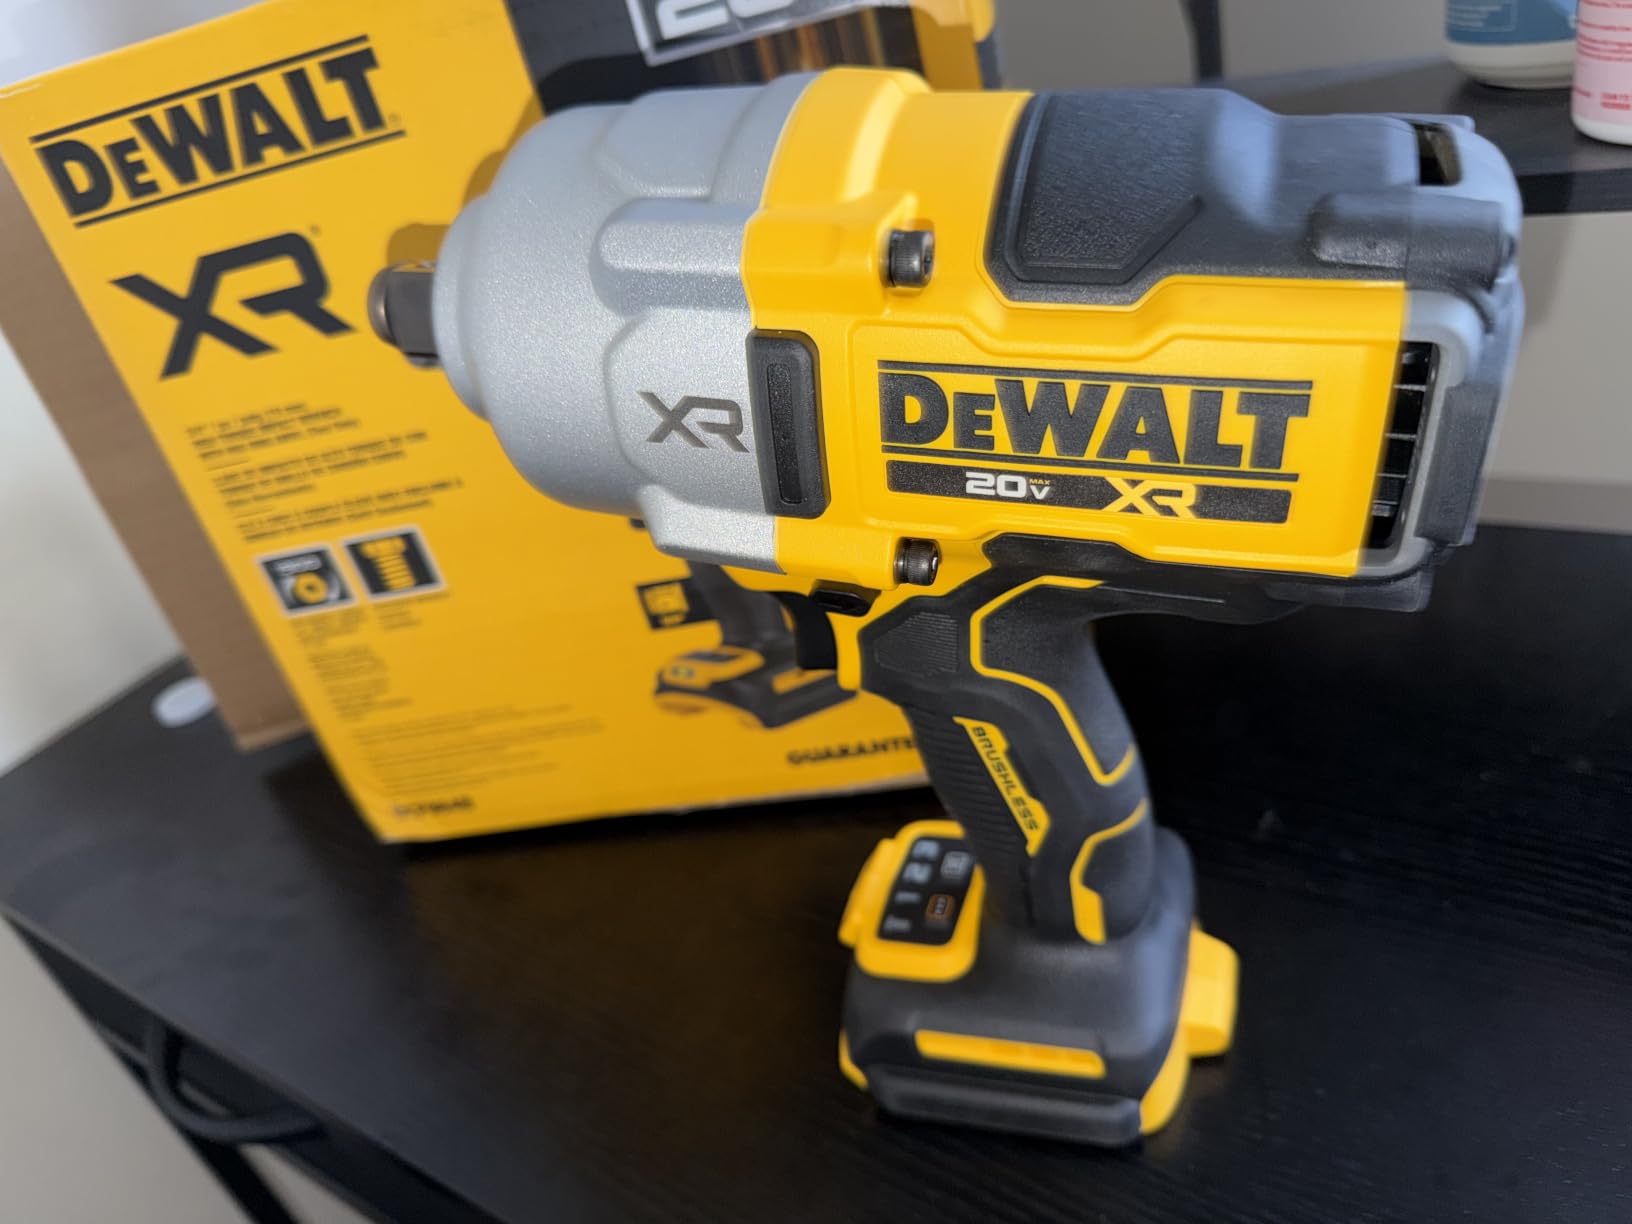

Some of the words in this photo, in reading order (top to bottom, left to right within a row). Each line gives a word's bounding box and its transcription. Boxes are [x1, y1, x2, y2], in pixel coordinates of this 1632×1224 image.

[35, 46, 386, 217] DEWALT
[109, 231, 357, 380] XR
[636, 390, 751, 454] XR
[878, 372, 1310, 469] DEWALT
[1029, 478, 1051, 486] MAX
[1100, 476, 1199, 520] XR
[973, 726, 1040, 832] BRUSHLESS
